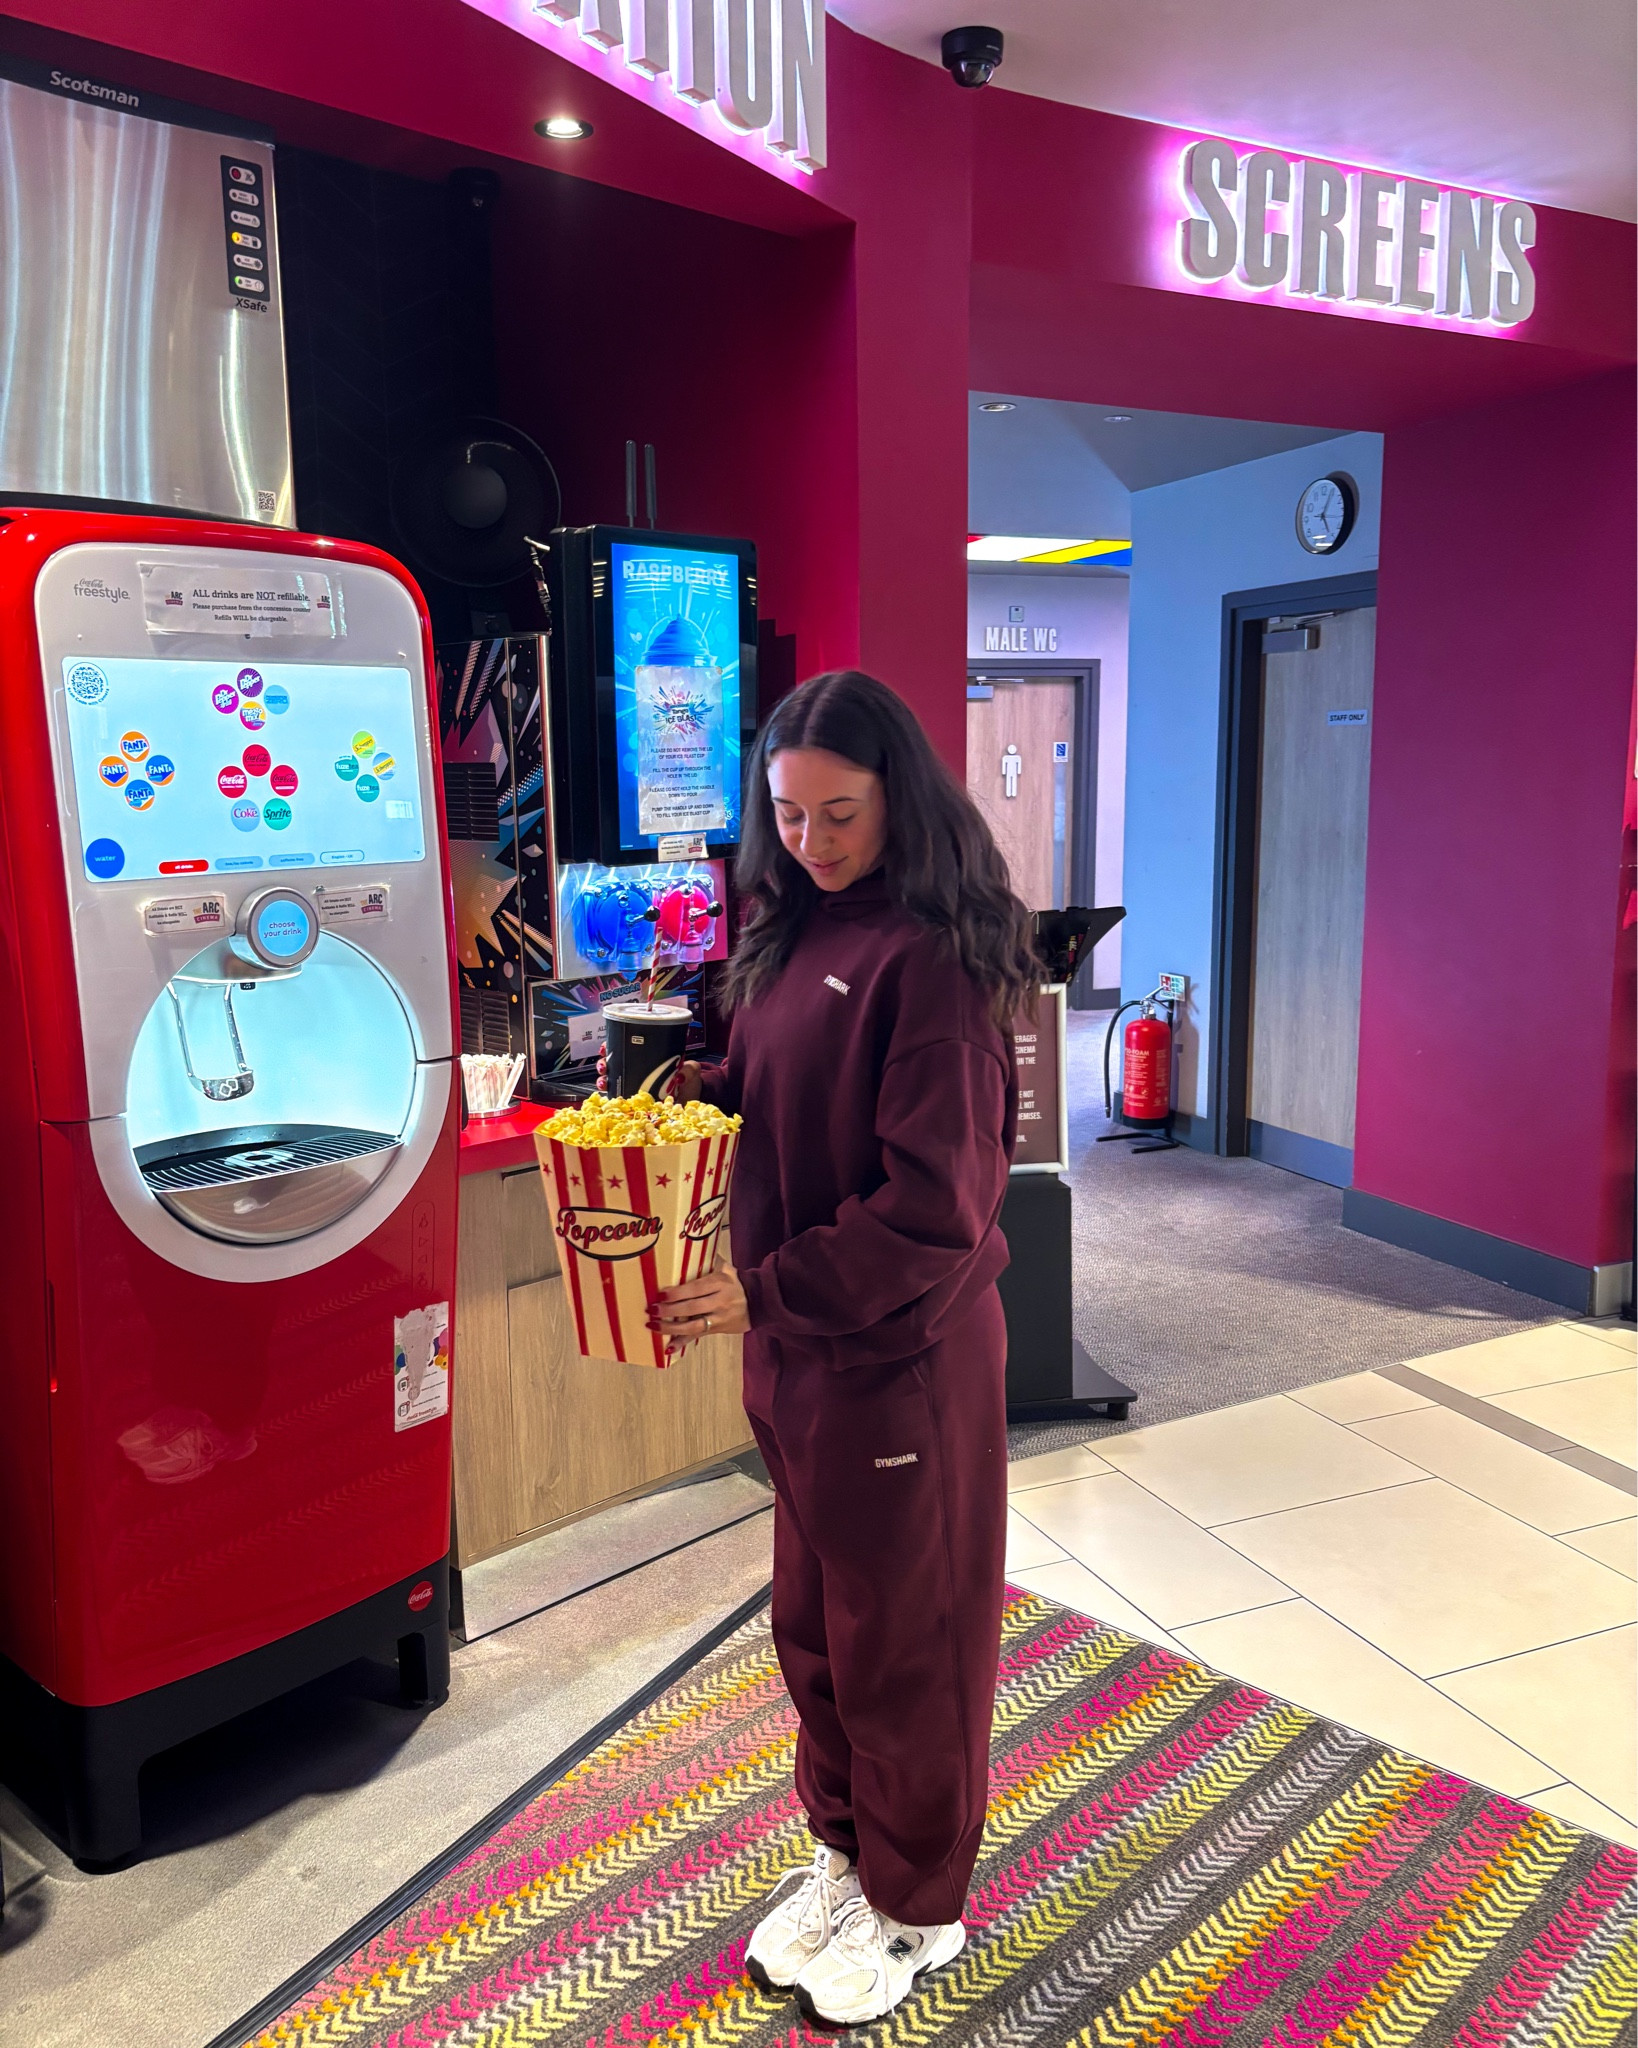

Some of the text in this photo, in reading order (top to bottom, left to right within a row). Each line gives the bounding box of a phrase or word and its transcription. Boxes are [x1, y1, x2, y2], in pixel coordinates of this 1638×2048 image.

[50, 71, 139, 107] Scotsman
[1183, 139, 1536, 326] SCREENS
[235, 297, 267, 312] XSafe
[623, 560, 729, 586] RASPBERRY
[74, 584, 129, 603] freestyle
[193, 589, 210, 598] ALL
[212, 590, 239, 599] drinks
[256, 591, 276, 601] NOT
[985, 627, 1058, 651] MALE WC
[122, 740, 148, 750] FANTA
[101, 765, 127, 775] FANTA
[148, 764, 173, 775] FANTA
[128, 788, 153, 799] FANTA
[234, 808, 259, 818] Coke
[264, 808, 291, 820] Sprite
[368, 893, 383, 905] ARC
[202, 901, 220, 914] ARC
[195, 915, 219, 923] CINEMA
[269, 921, 296, 929] choose
[282, 928, 302, 936] drink
[600, 989, 613, 1002] NO
[612, 981, 641, 998] SUGAR
[1014, 1034, 1037, 1043] ERAGES
[556, 1208, 663, 1249] Popcorn
[875, 1452, 919, 1468] GYMSHARK
